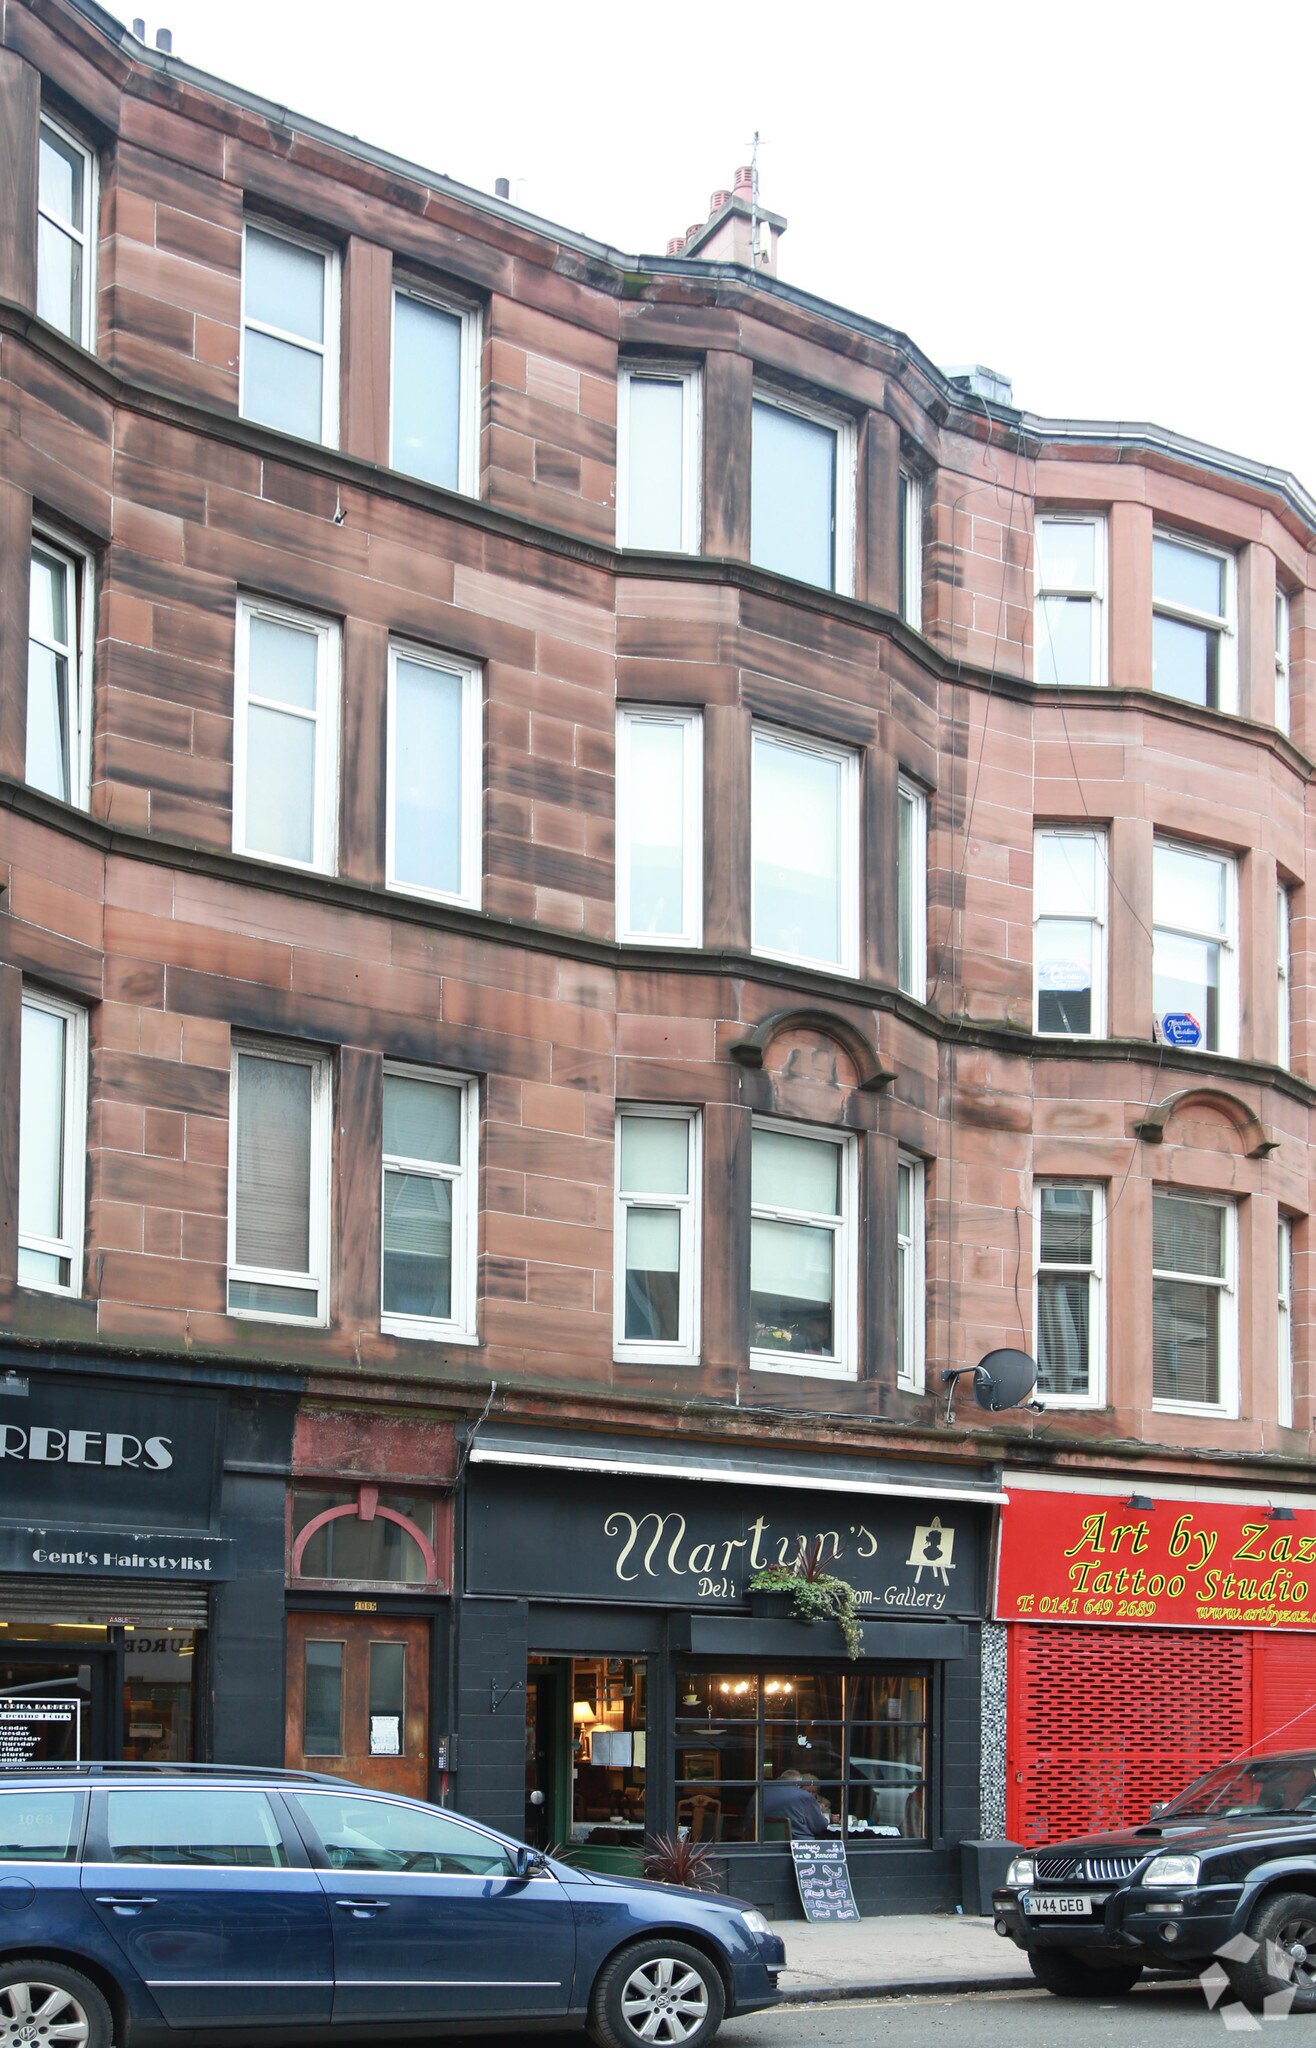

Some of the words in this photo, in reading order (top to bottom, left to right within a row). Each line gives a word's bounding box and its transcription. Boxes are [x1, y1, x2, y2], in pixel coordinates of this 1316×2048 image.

[1064, 1511, 1150, 1558] Art
[1168, 1514, 1218, 1571] by
[32, 1549, 98, 1567] Gent's
[103, 1553, 212, 1571] Hairstylist
[698, 1577, 736, 1598] Deli
[1069, 1560, 1186, 1598] Tattoo
[1196, 1567, 1309, 1603] Studio
[884, 1586, 946, 1610] Gallery
[1039, 1596, 1079, 1615] 0141
[1083, 1598, 1114, 1616] 649
[1116, 1599, 1157, 1618] 2689
[1035, 1899, 1056, 1912] V44
